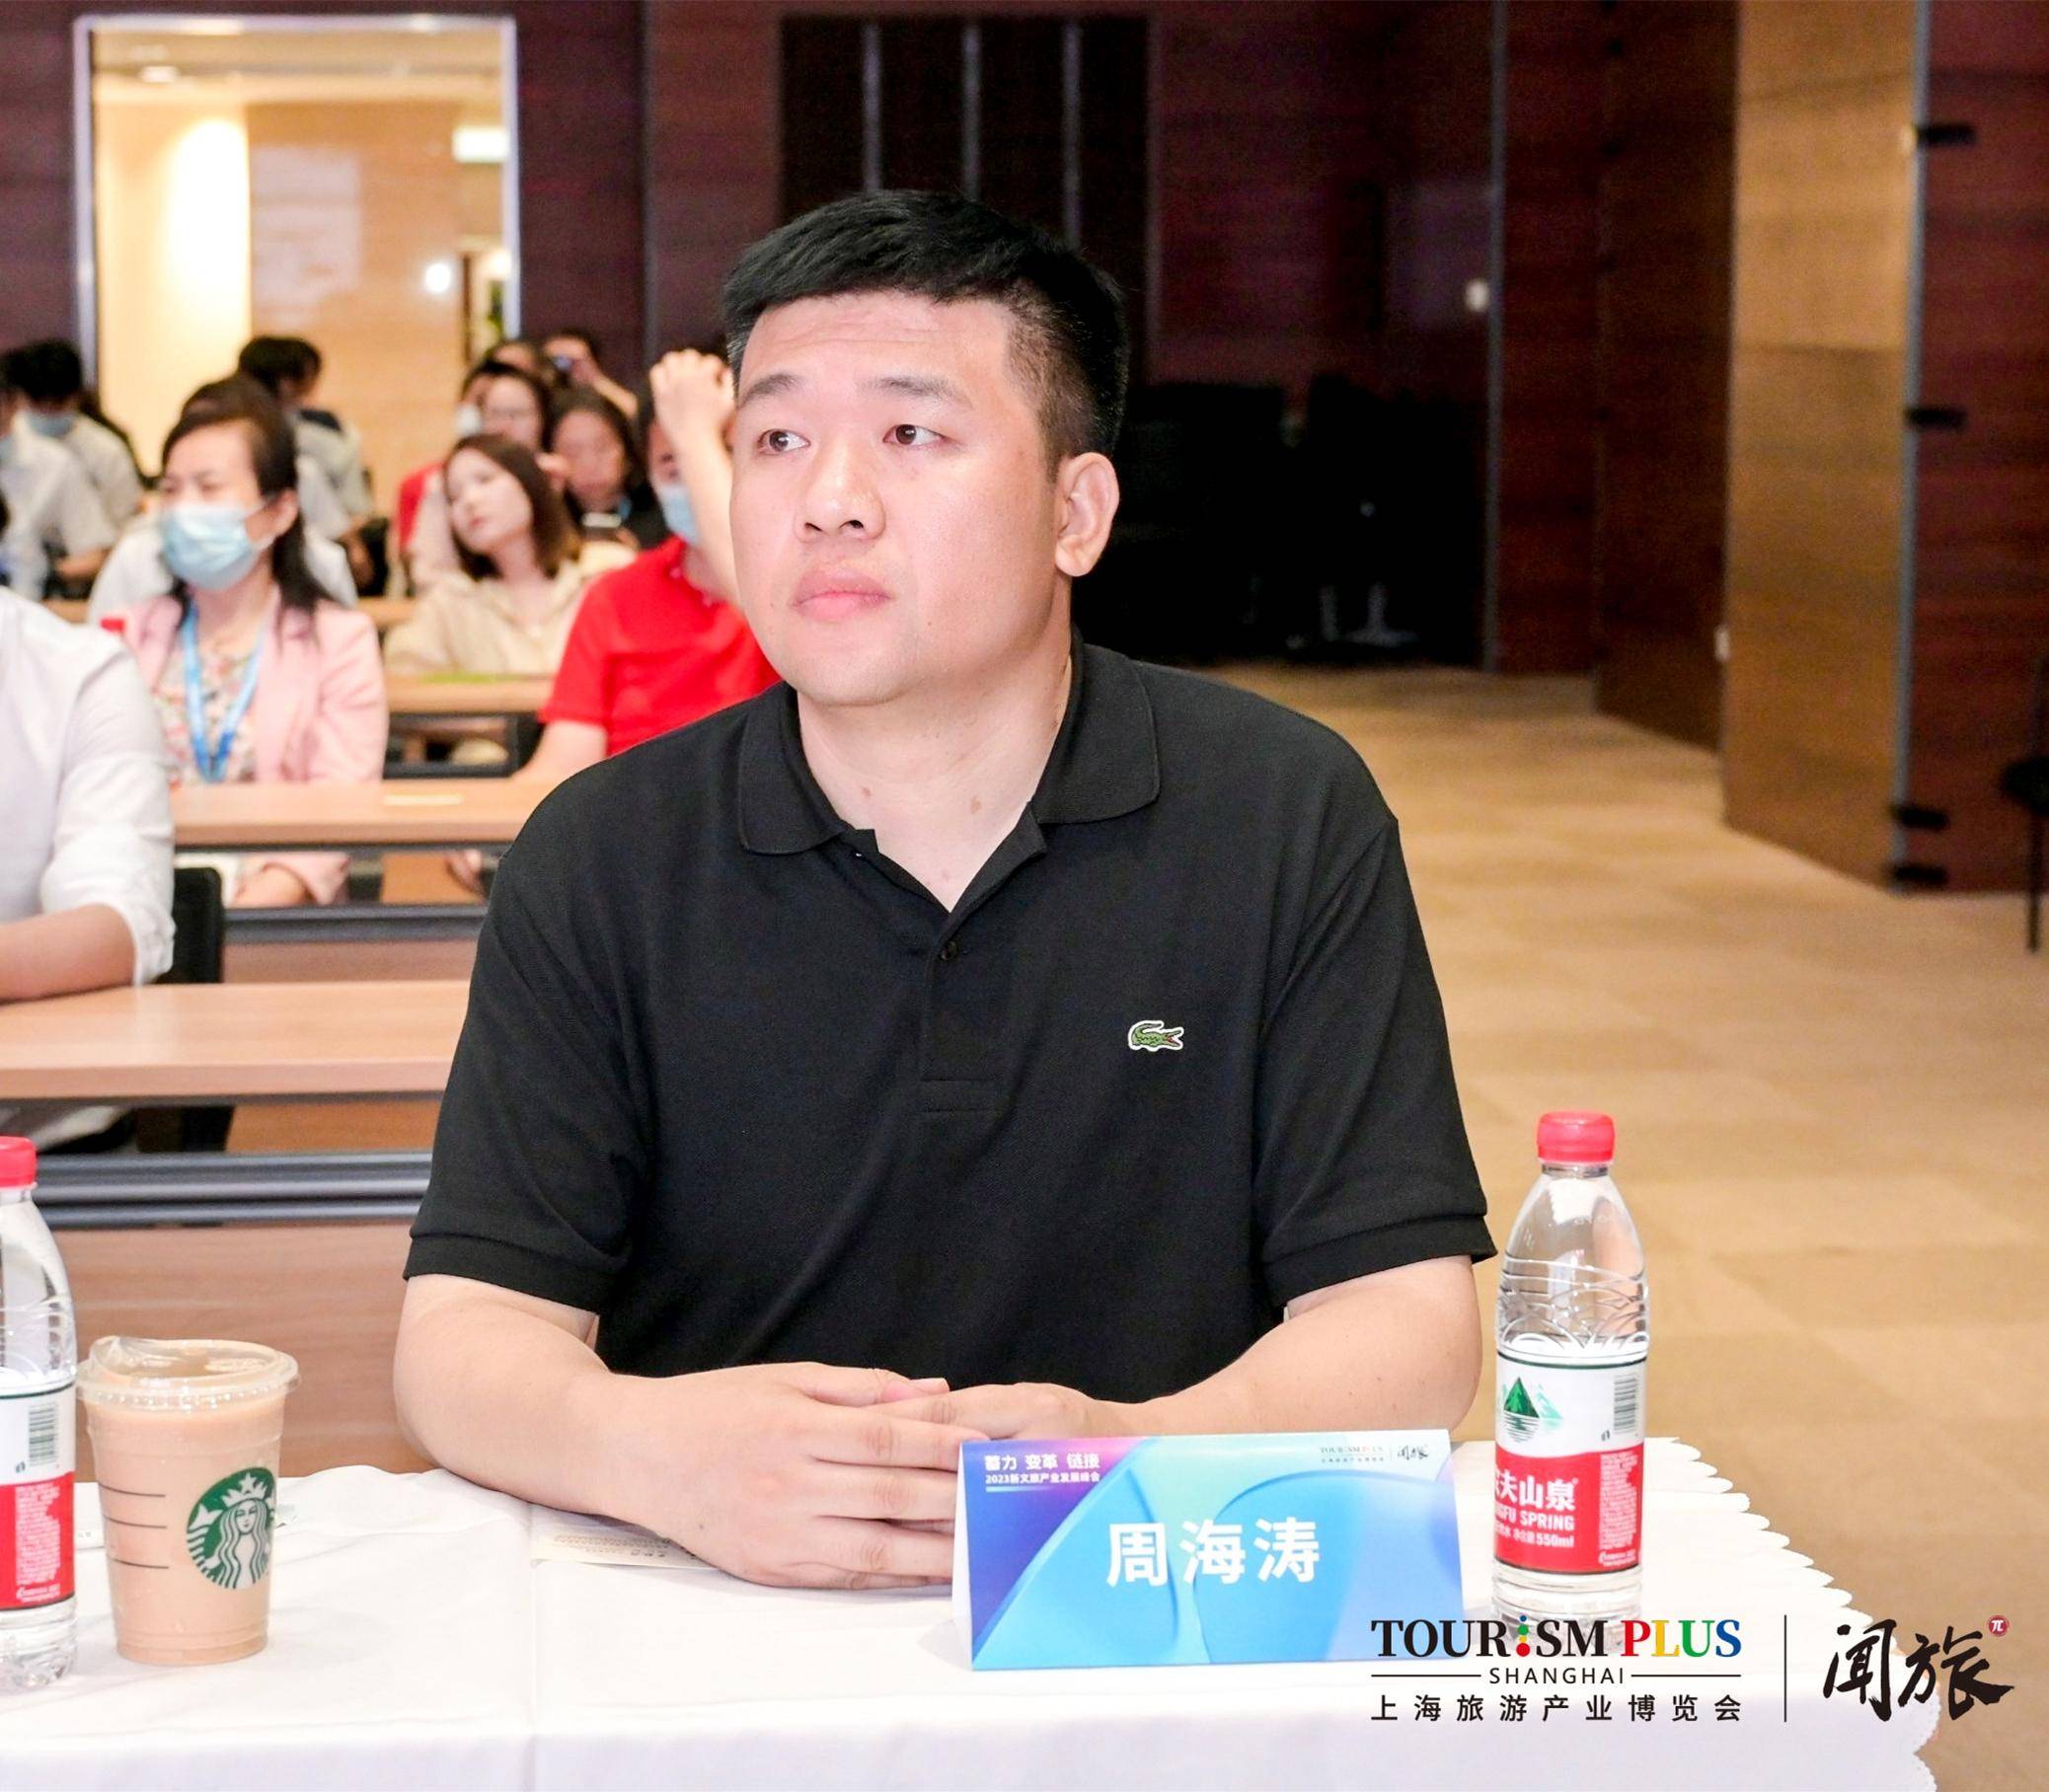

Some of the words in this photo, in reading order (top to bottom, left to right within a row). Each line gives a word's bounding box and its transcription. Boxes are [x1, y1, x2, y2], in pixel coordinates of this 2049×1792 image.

[1024, 1454, 1059, 1470] 变革
[1067, 1453, 1100, 1469] 链接
[1520, 1509, 1575, 1531] SPRING
[1106, 1516, 1321, 1588] 周海涛
